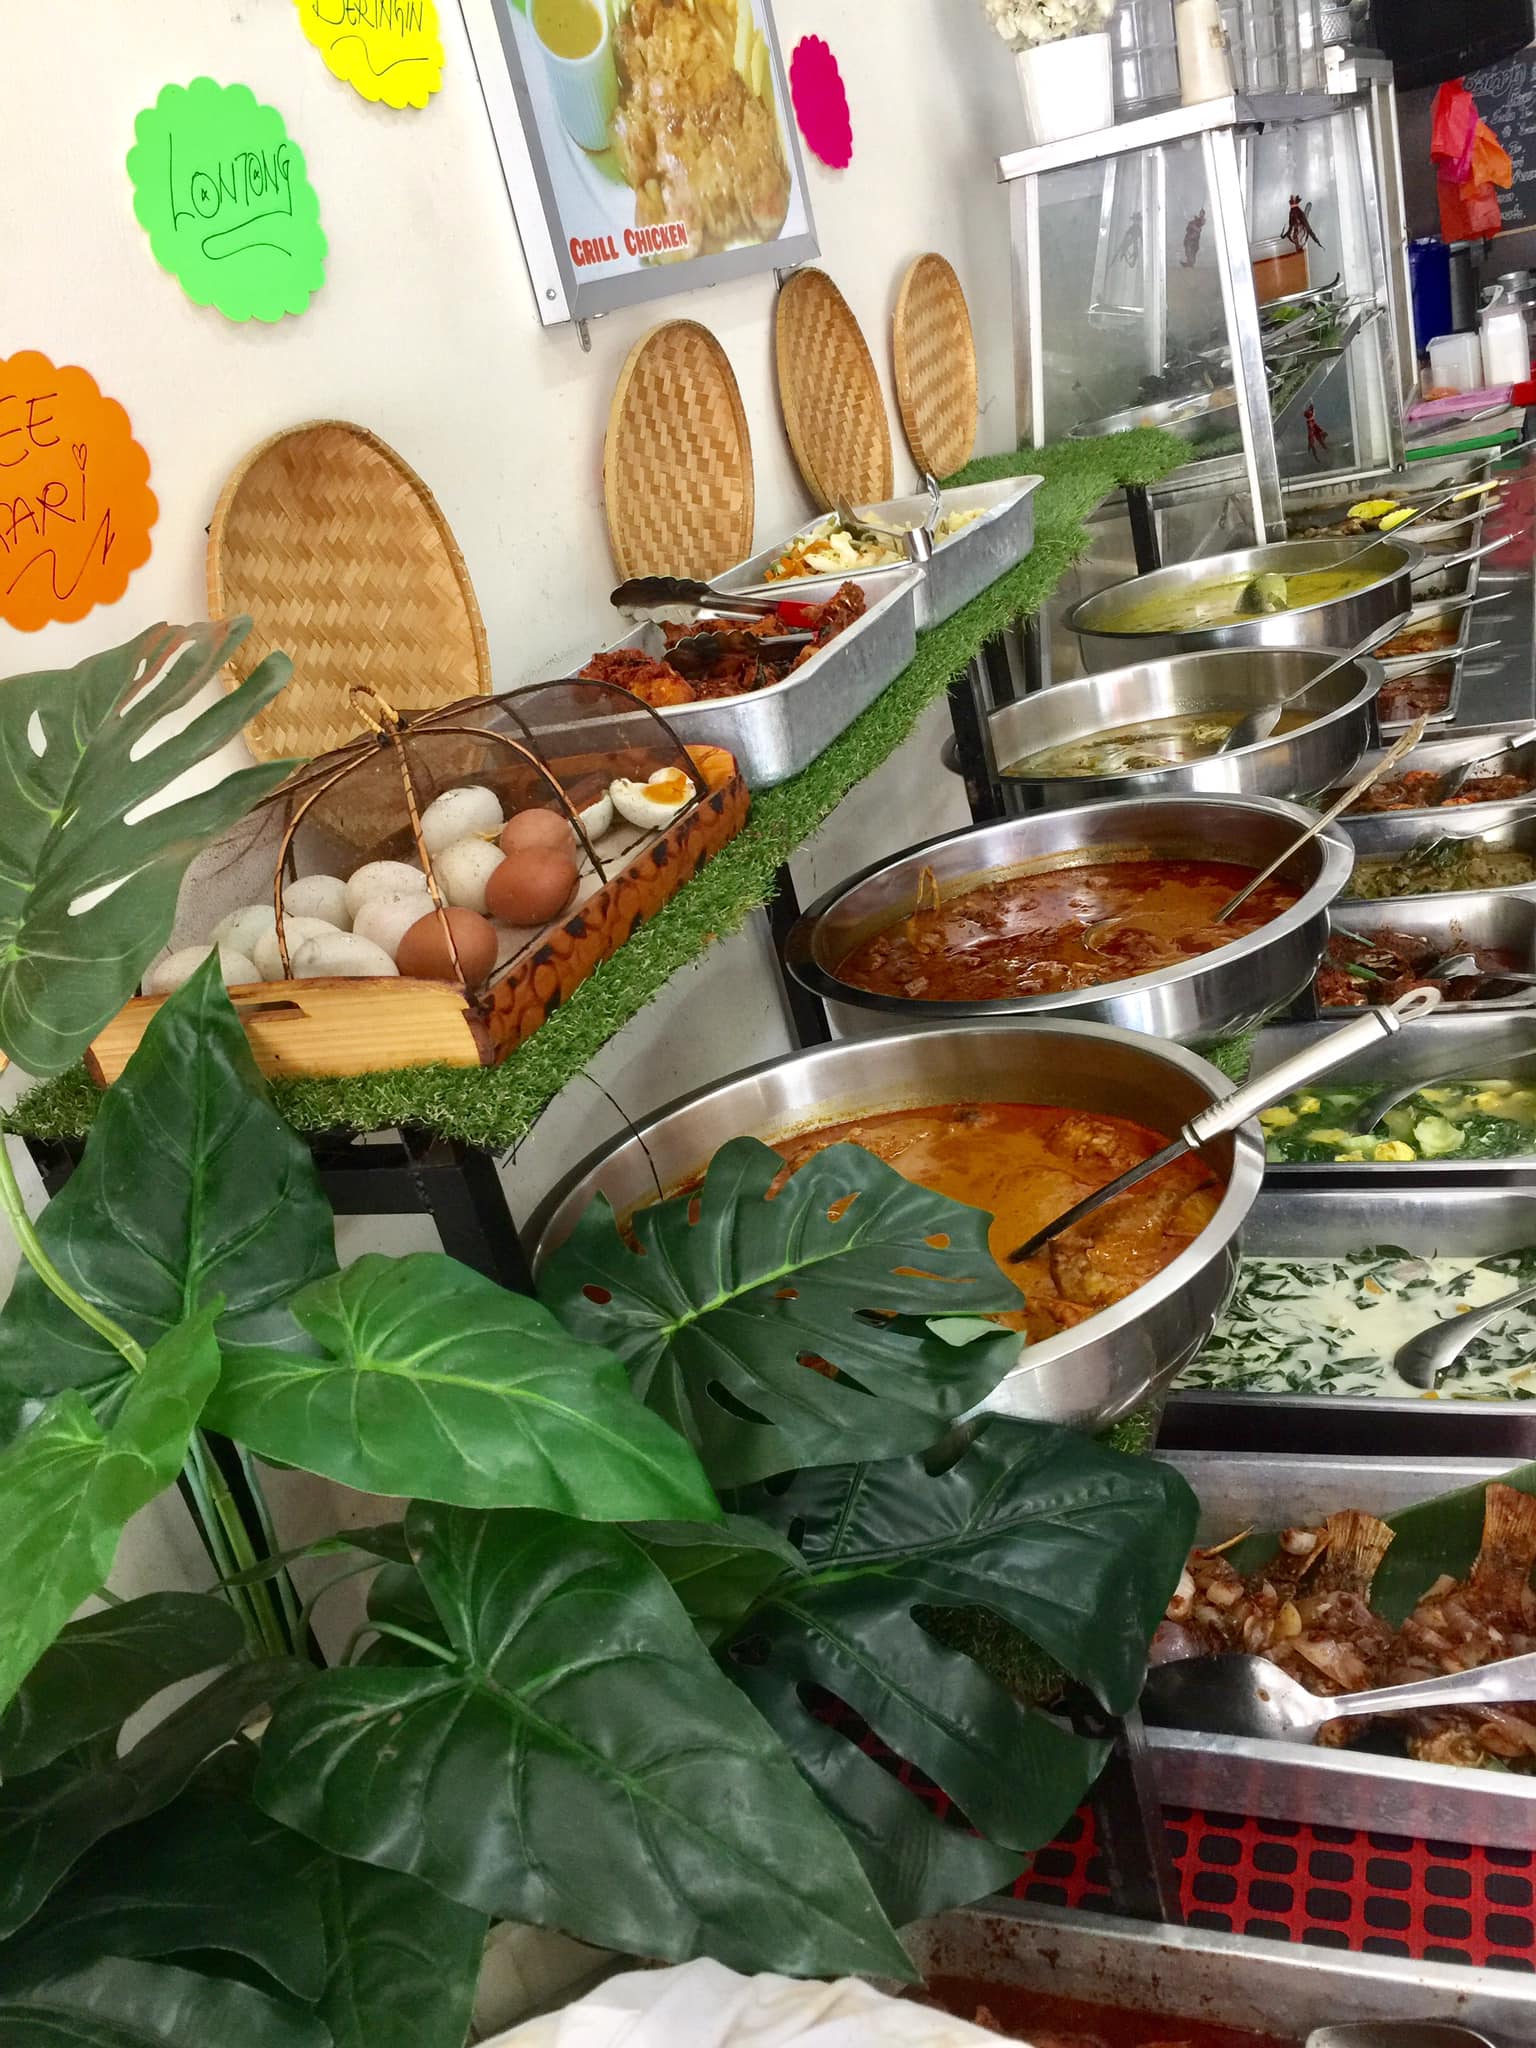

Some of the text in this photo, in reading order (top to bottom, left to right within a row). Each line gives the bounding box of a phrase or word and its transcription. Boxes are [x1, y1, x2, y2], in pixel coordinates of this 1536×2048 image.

[168, 132, 293, 232] LONTONG
[569, 222, 690, 268] GRILL CHICKEN
[0, 443, 88, 554] ARI
